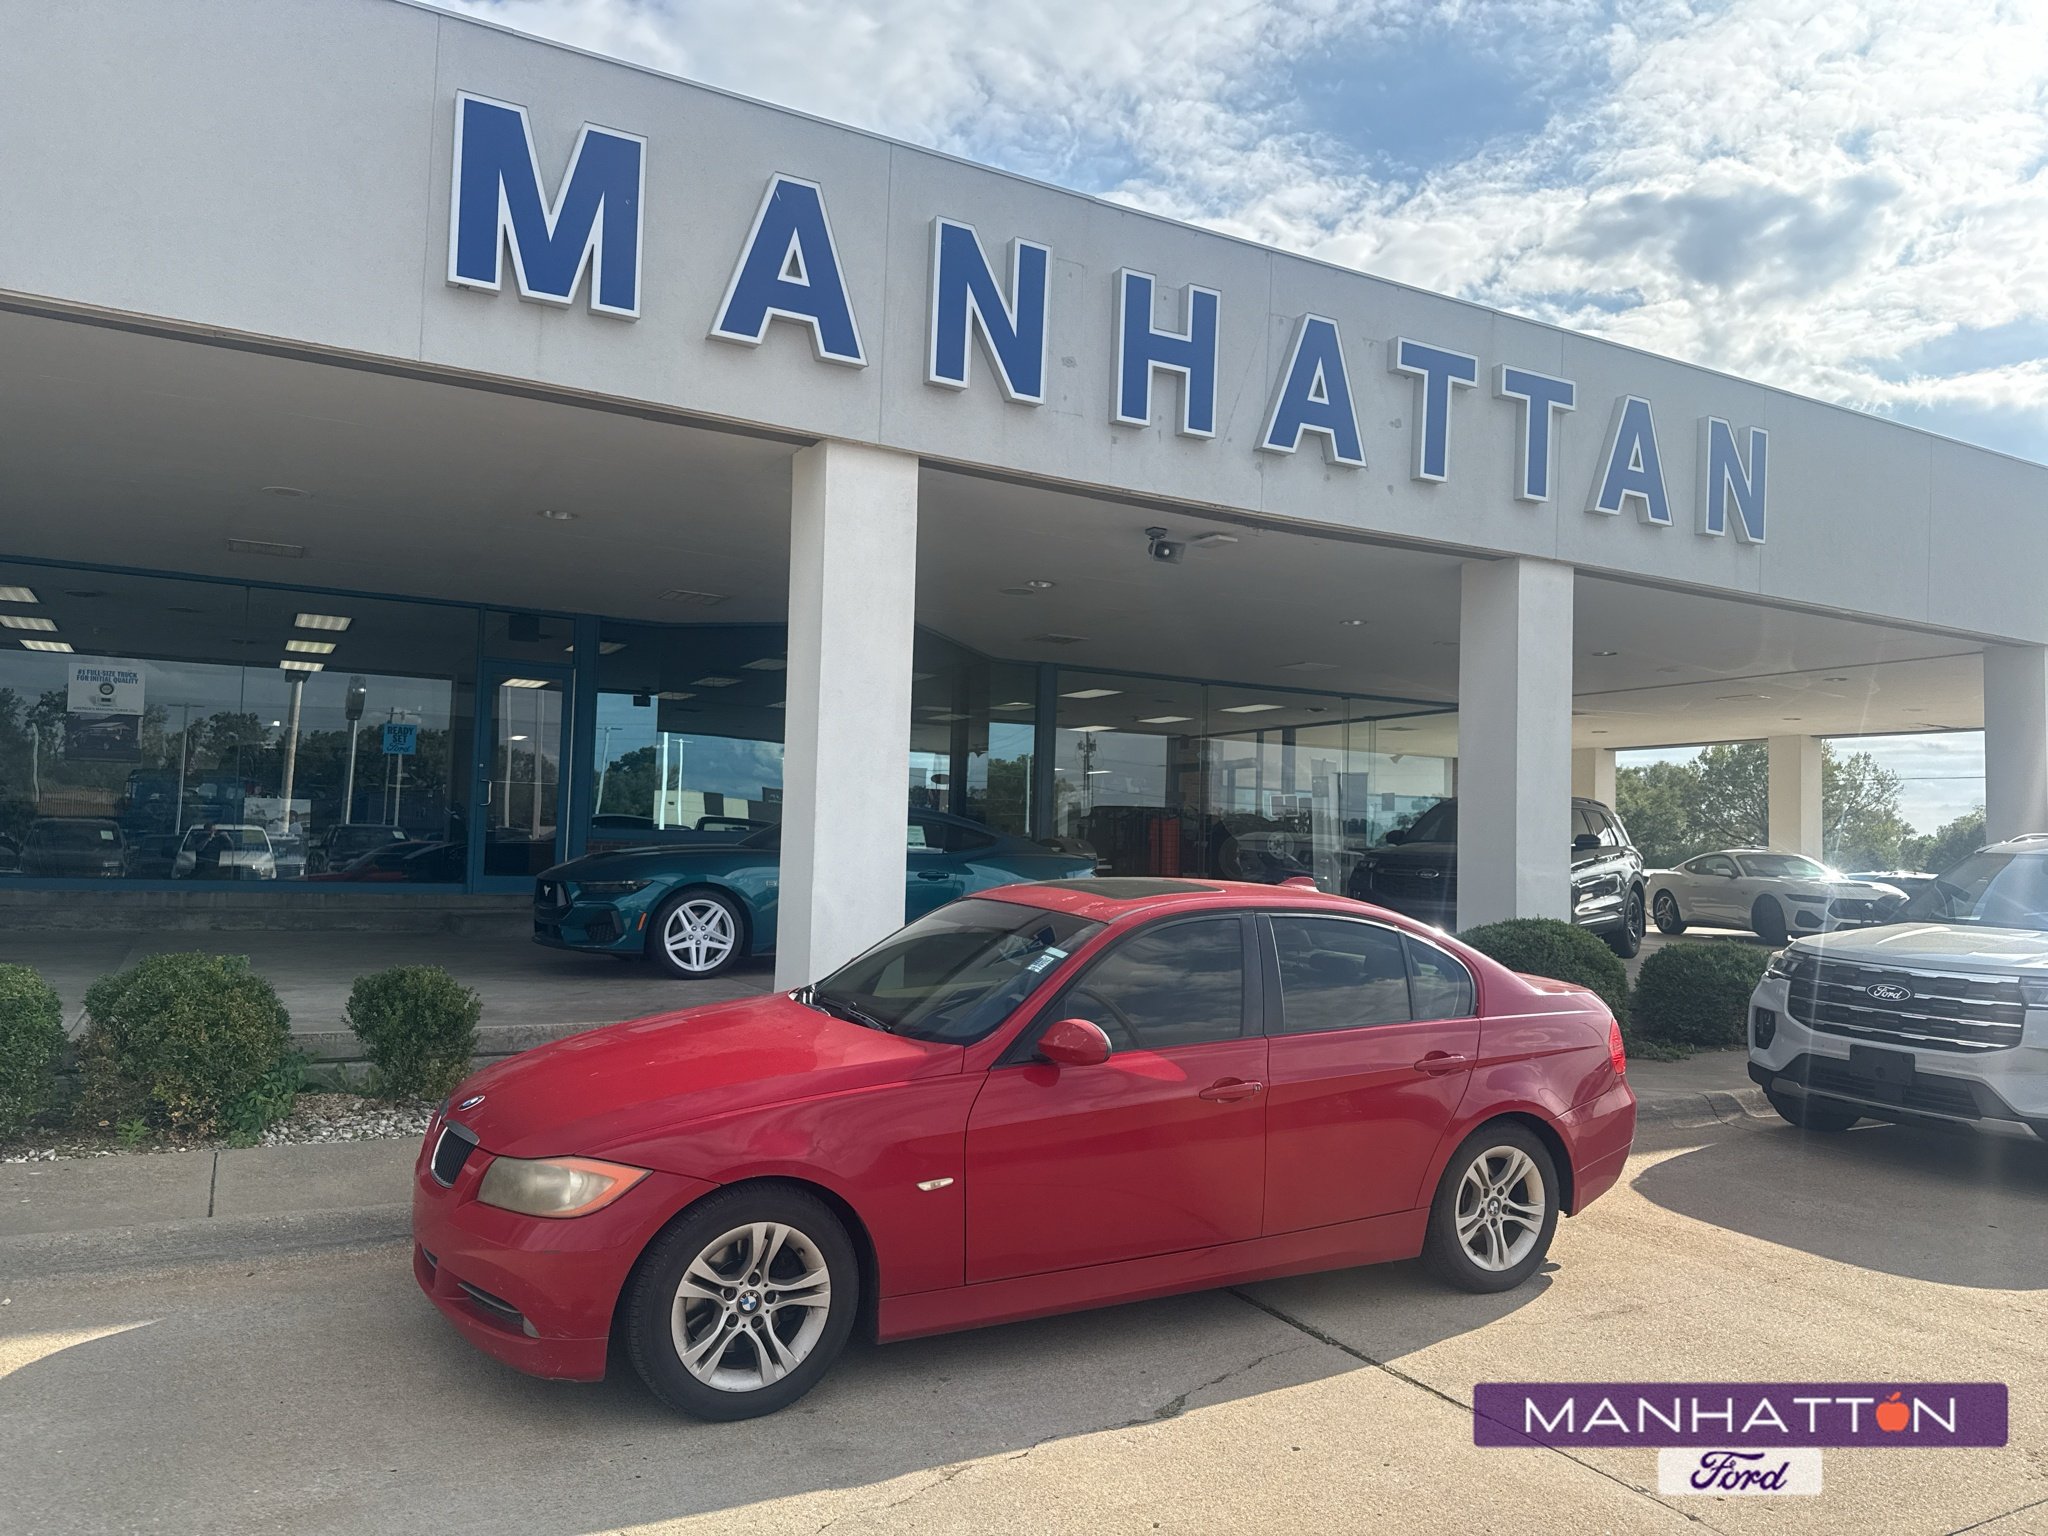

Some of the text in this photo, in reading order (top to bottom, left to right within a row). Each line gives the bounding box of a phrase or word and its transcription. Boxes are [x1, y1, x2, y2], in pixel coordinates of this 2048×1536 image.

[449, 91, 1768, 543] MANHATTAN
[387, 726, 414, 735] READY
[392, 735, 407, 743] SET
[386, 743, 412, 752] Ford
[1873, 986, 1903, 999] Ford
